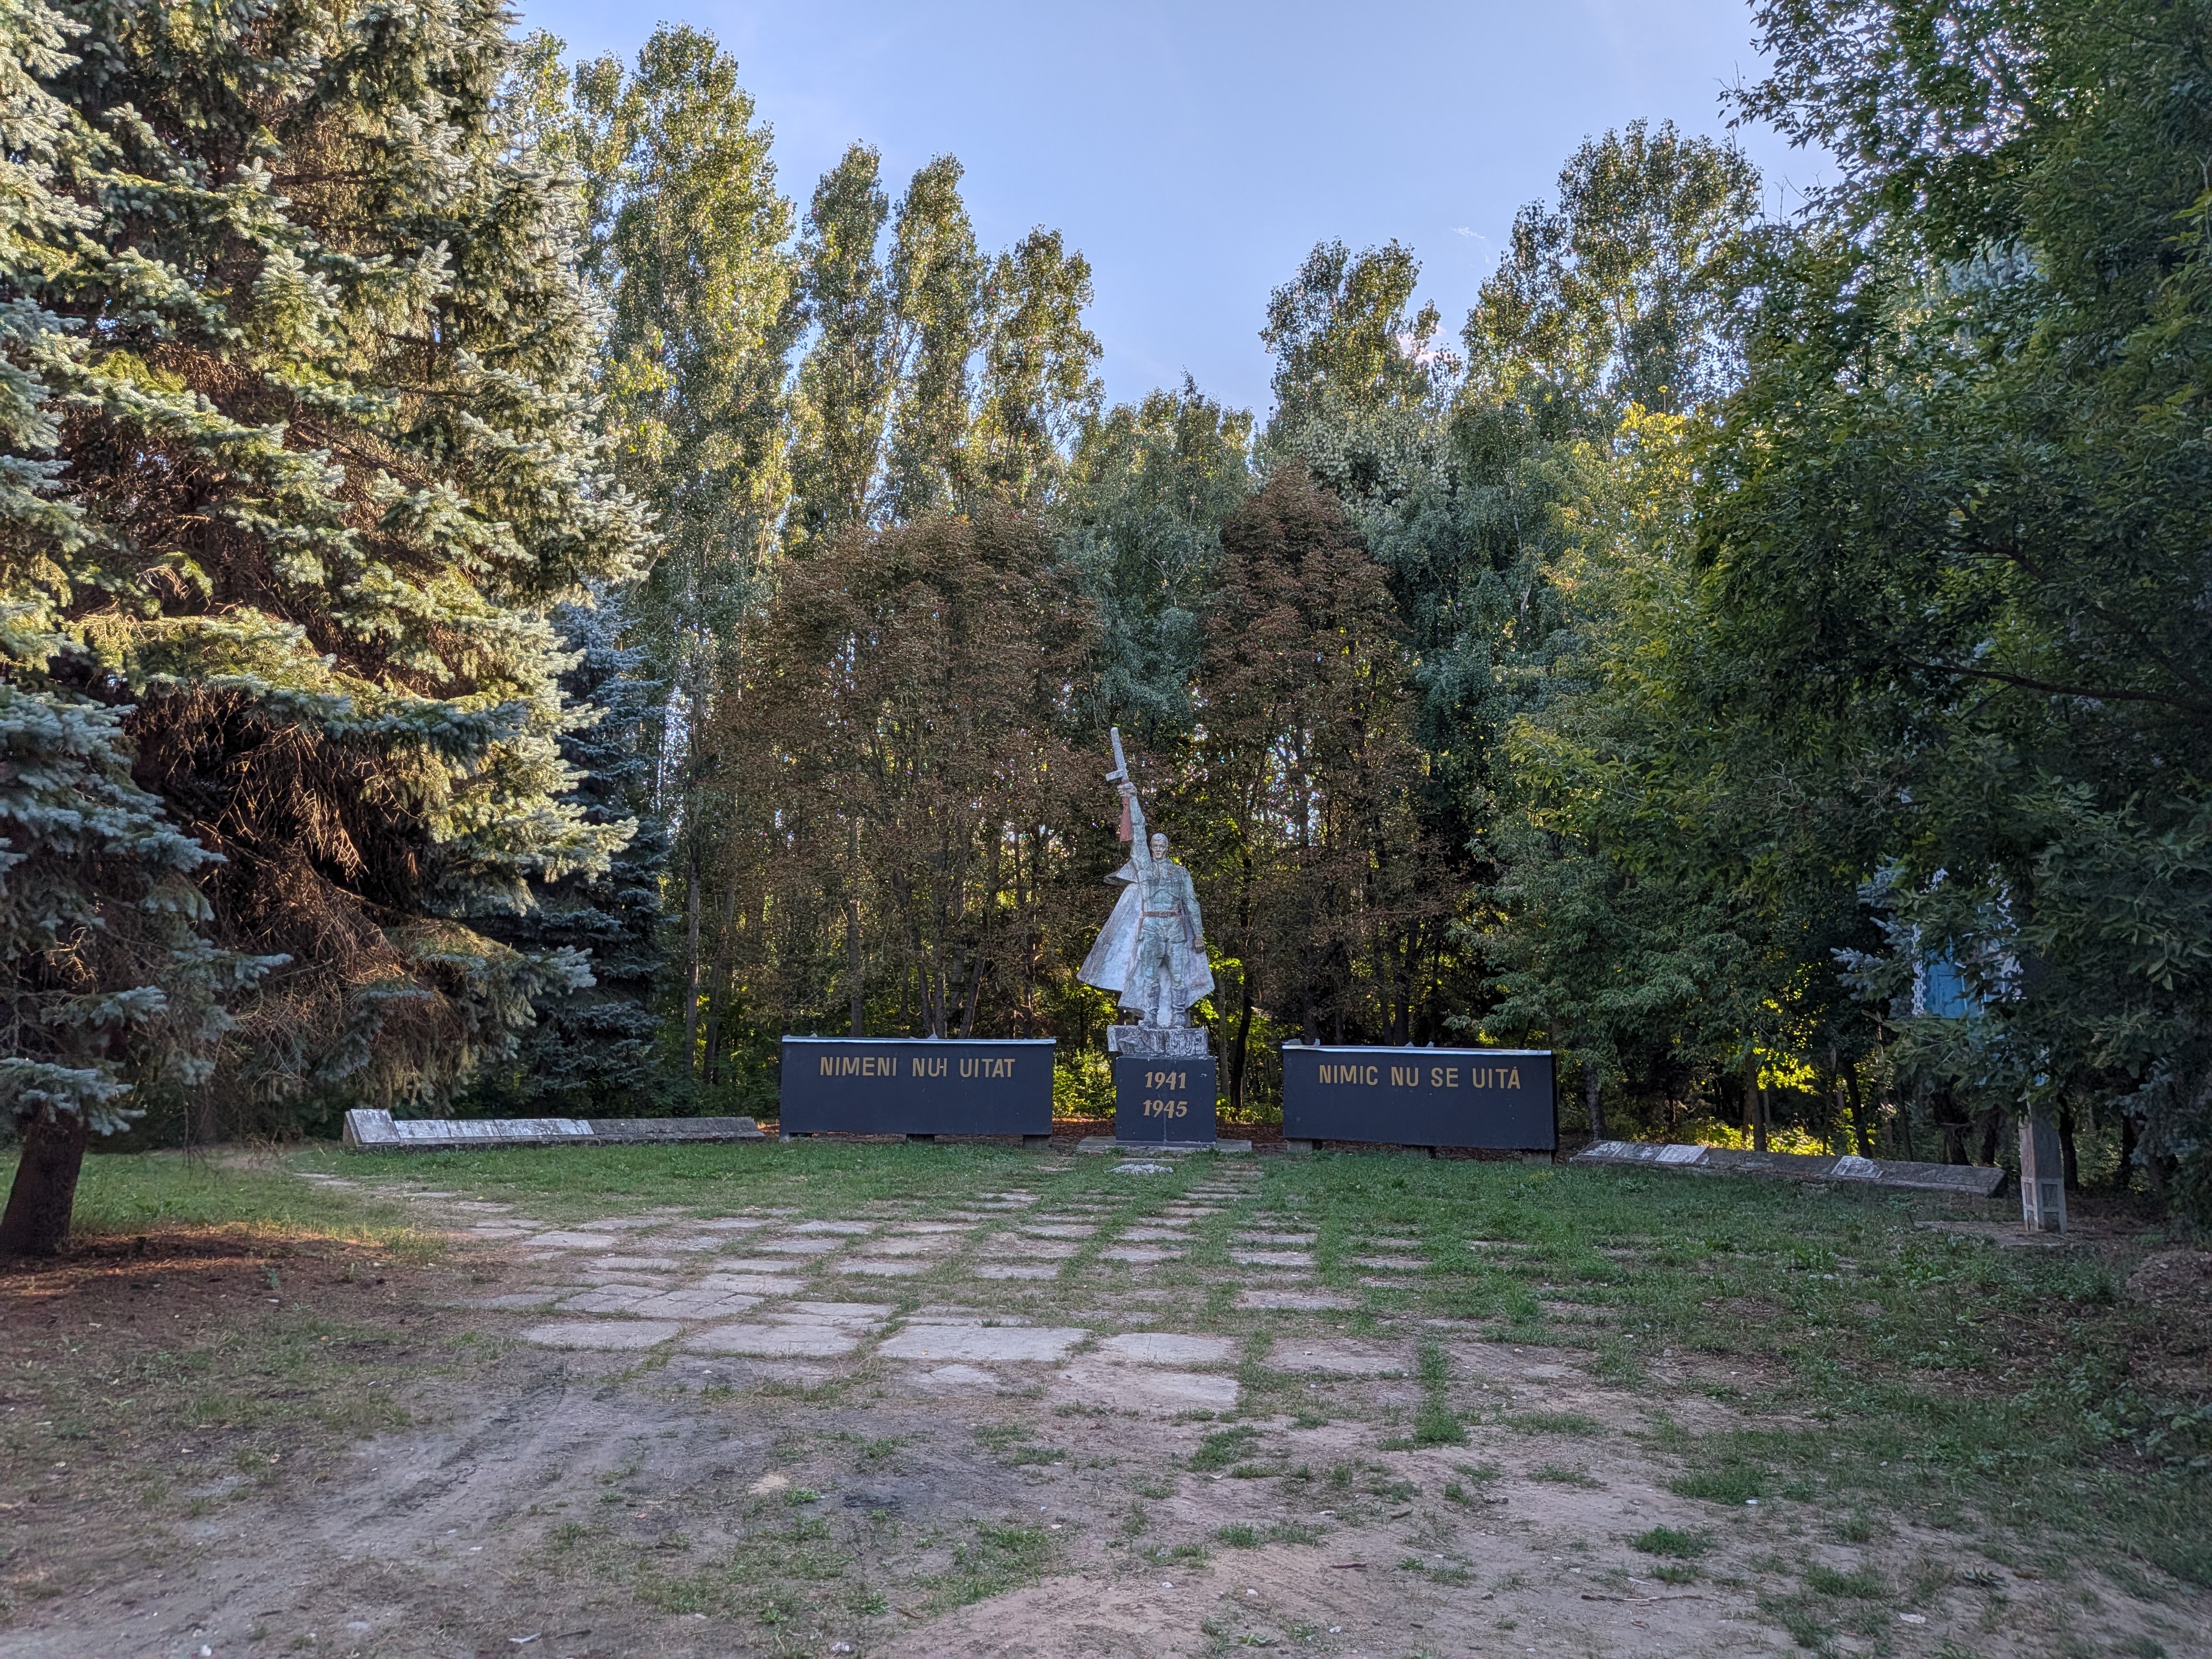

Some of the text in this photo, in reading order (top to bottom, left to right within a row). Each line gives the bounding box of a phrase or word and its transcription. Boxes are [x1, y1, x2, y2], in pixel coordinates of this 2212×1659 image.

[820, 1057, 897, 1076] NIMENI
[959, 1058, 1015, 1078] UITAT
[1319, 1065, 1378, 1086] NIMIC
[1391, 1066, 1419, 1087] NU
[1431, 1067, 1459, 1087] SE
[1145, 1072, 1186, 1090] 1941
[1142, 1099, 1187, 1118] 1945
